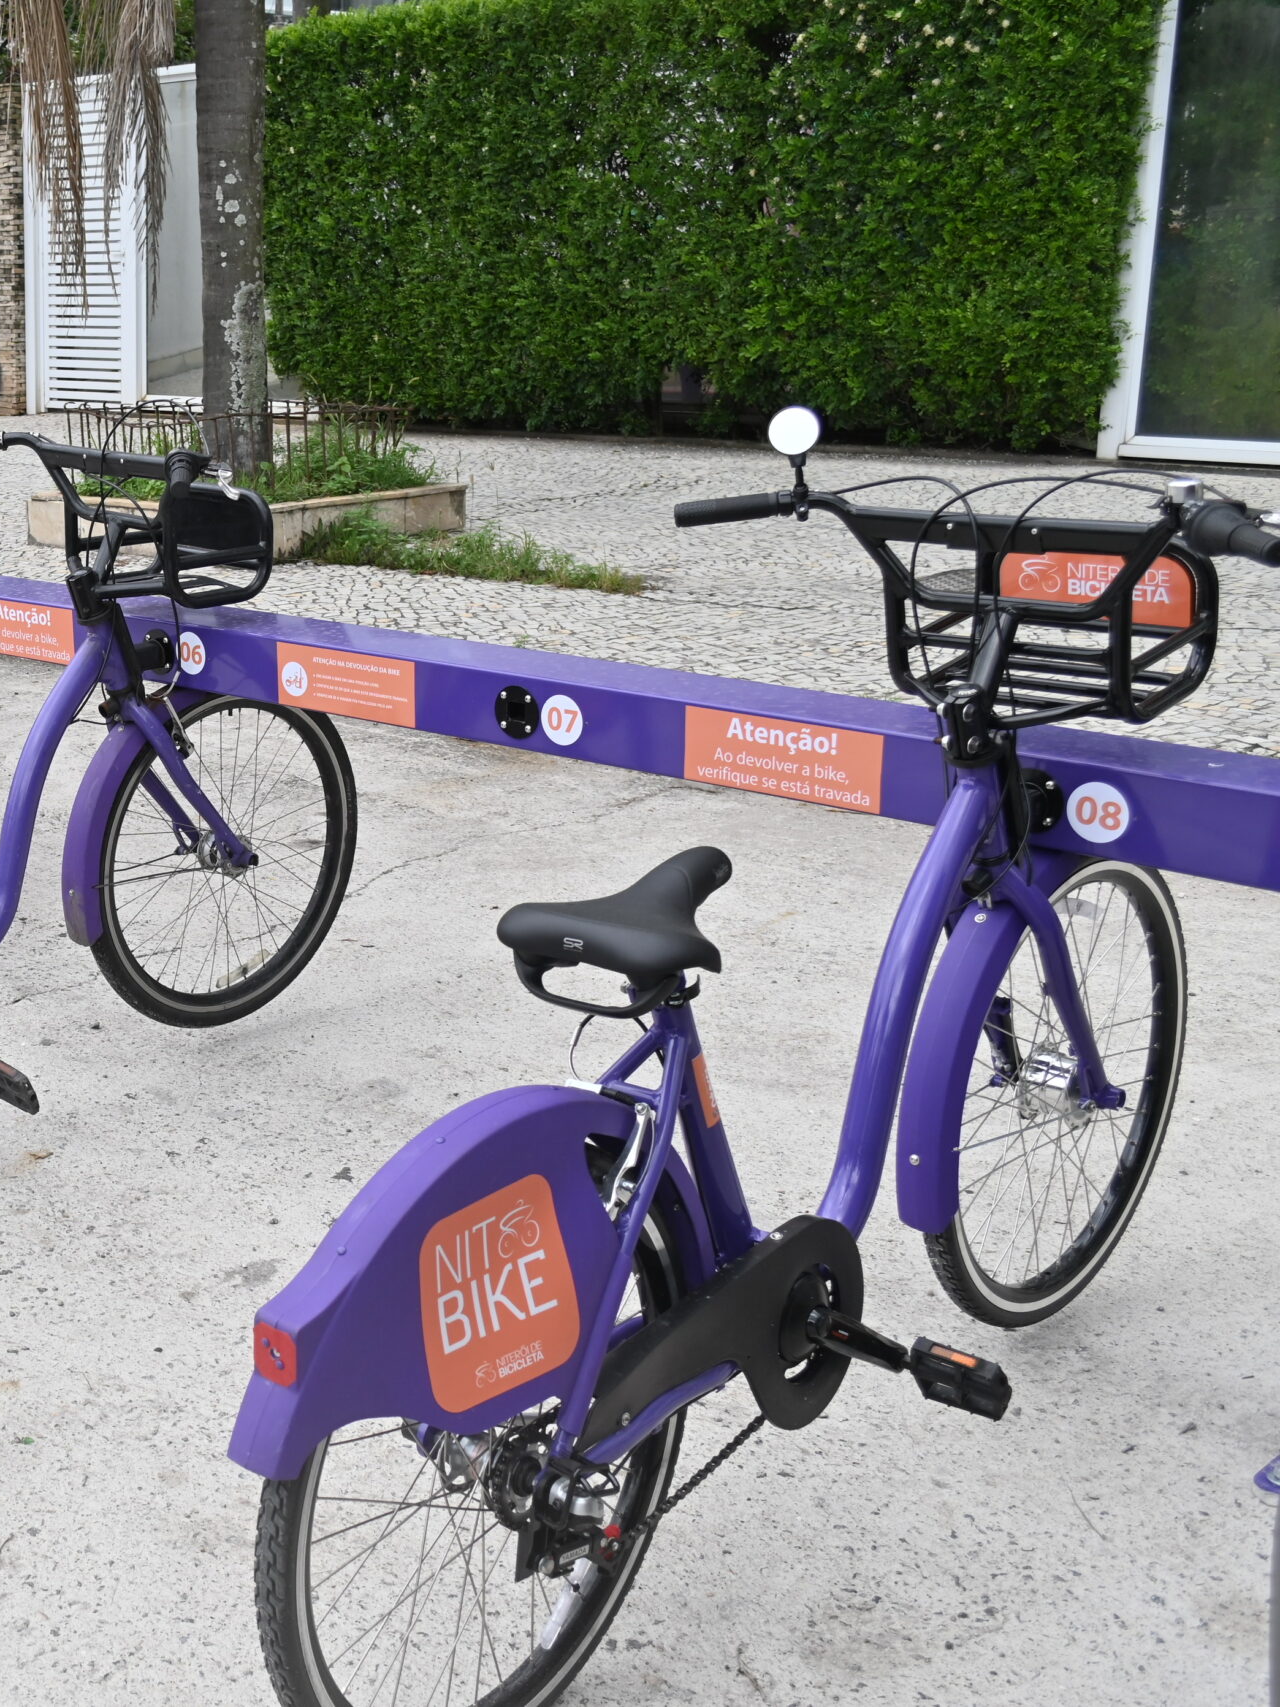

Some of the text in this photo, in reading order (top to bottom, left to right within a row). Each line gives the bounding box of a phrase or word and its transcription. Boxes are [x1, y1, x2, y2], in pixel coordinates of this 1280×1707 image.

[1067, 562, 1170, 586] NITER DE
[1, 627, 33, 642] devolver
[34, 634, 40, 643] a
[40, 632, 59, 647] bike,
[15, 645, 24, 654] se
[25, 645, 41, 657] está
[42, 648, 70, 661] travada
[180, 641, 203, 665] 06
[313, 656, 336, 666] ATENÇÃO
[345, 662, 378, 673] DEVOLUÇÃO
[388, 668, 400, 676] BIKE
[547, 706, 578, 733] 07
[726, 717, 838, 755] Atenção!
[714, 747, 849, 785] Ao devolver a bike,
[697, 765, 870, 807] verifique se está travada
[1075, 796, 1122, 831] 08
[435, 1216, 497, 1293] NIT
[437, 1249, 559, 1355] BIKE
[496, 1340, 543, 1368] NITERÓI DE
[498, 1351, 545, 1378] BICICLETA
